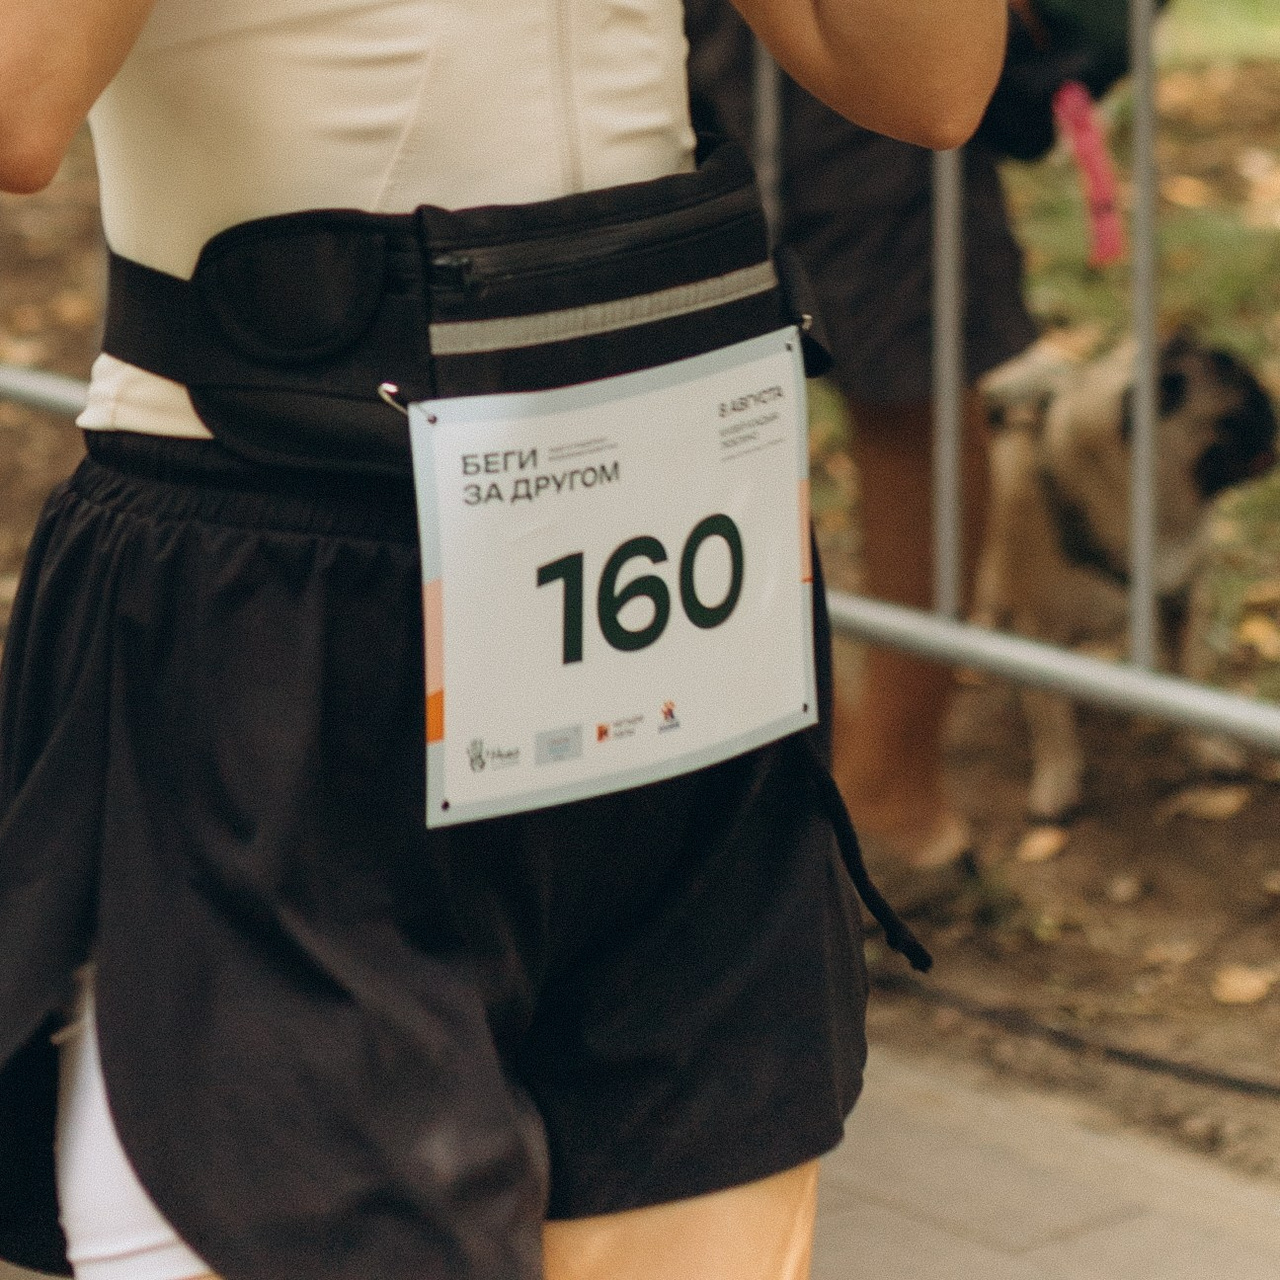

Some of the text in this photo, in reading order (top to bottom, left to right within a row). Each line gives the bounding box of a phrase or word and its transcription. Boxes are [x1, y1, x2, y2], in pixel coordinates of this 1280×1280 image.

[462, 448, 537, 476] БЕГИ
[463, 460, 620, 506] ЗА ДРУГОМ
[536, 513, 745, 665] 160
